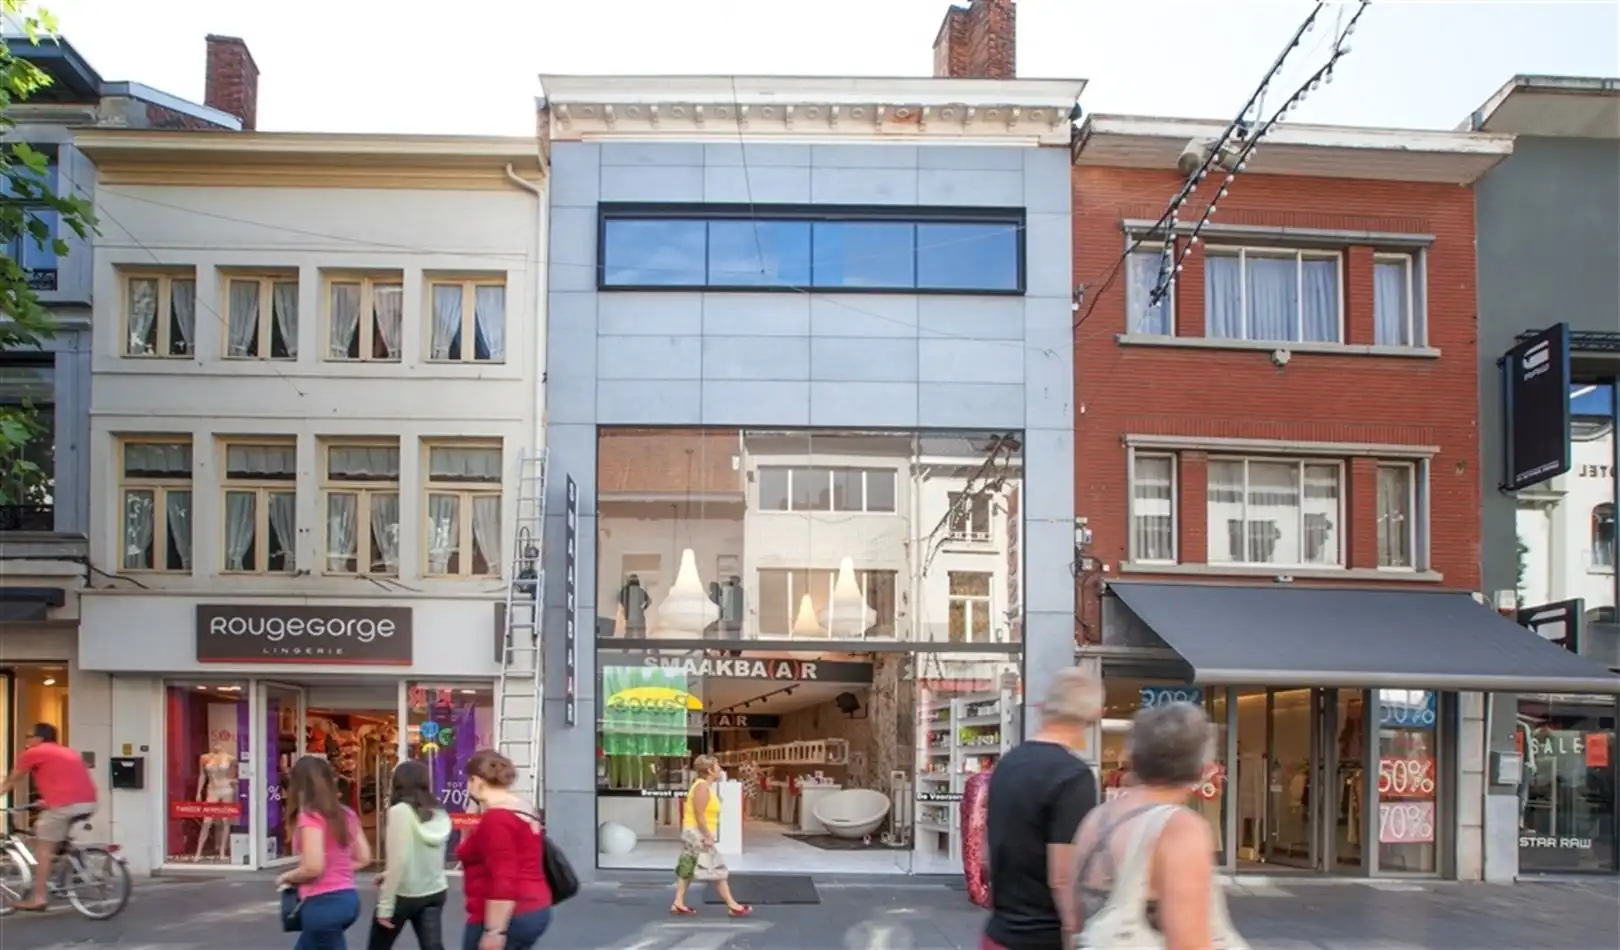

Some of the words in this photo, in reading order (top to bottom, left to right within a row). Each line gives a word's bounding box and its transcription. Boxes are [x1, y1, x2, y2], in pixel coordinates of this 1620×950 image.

[1530, 737, 1585, 754] SALE
[1378, 760, 1435, 793] 50%
[1379, 805, 1433, 839] 70%
